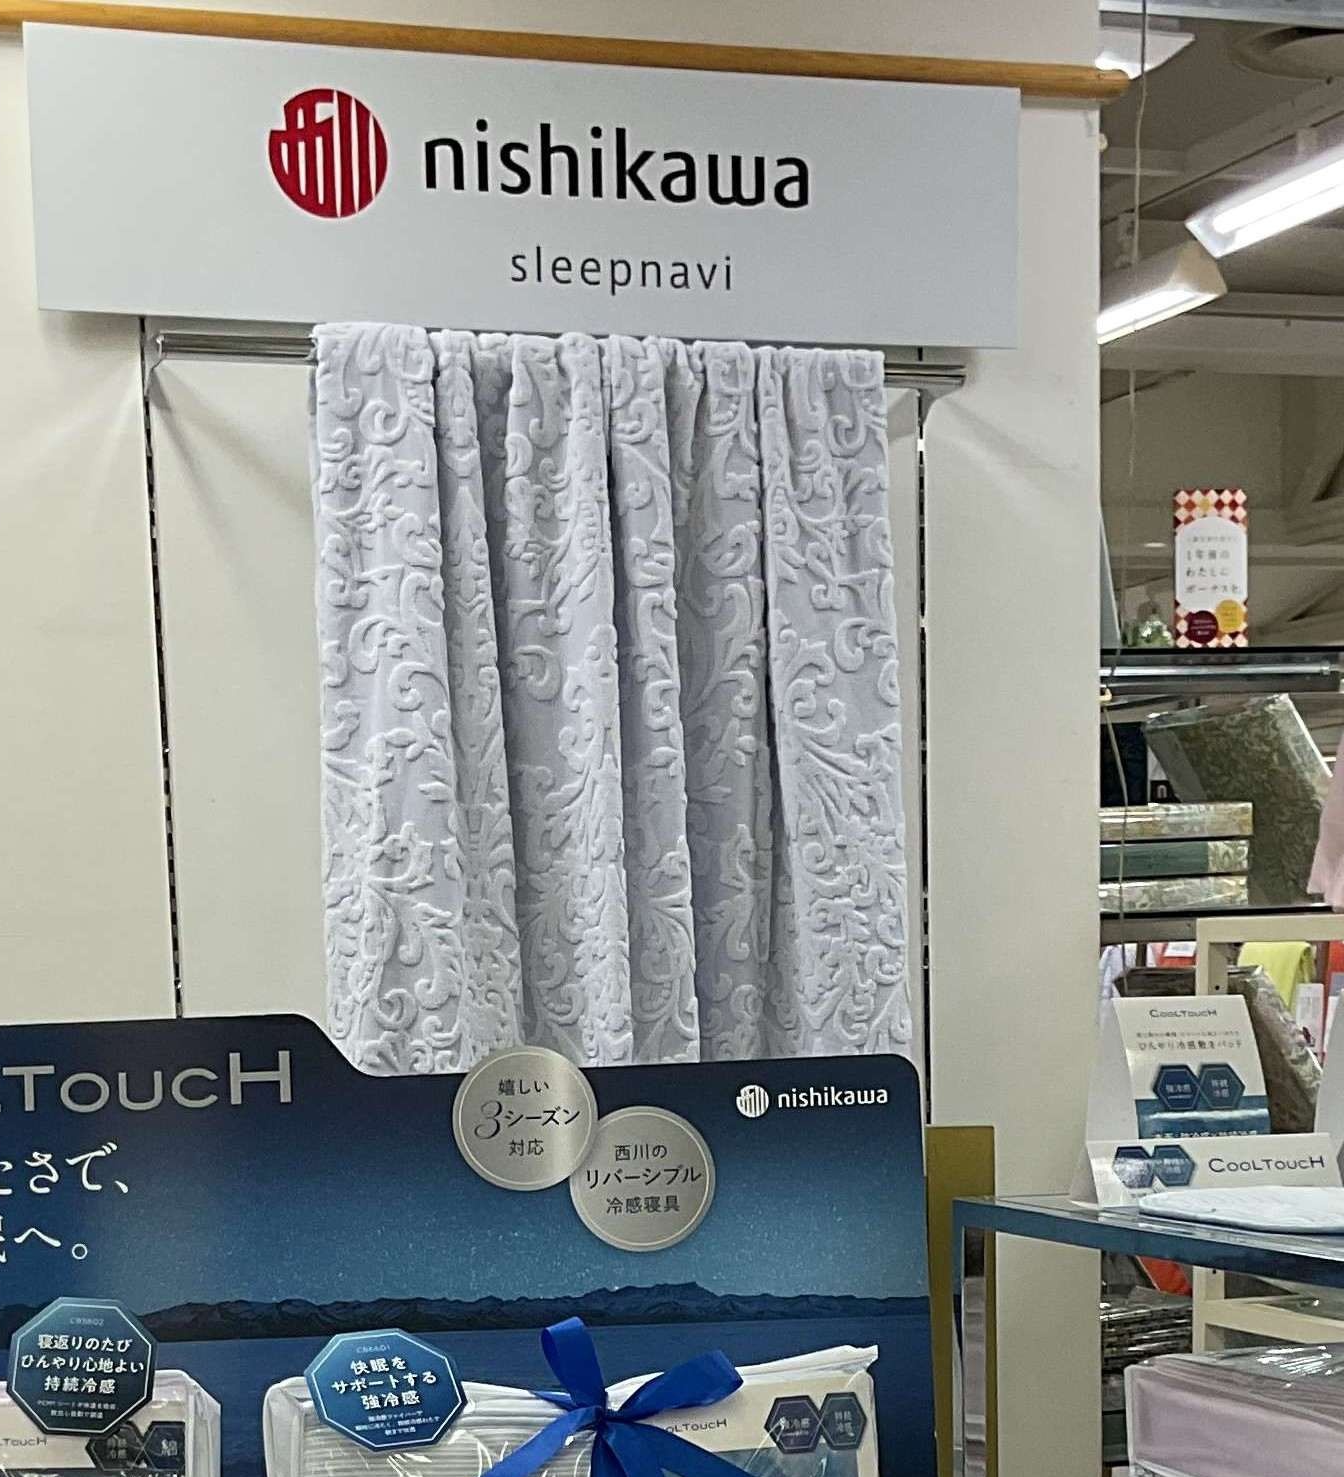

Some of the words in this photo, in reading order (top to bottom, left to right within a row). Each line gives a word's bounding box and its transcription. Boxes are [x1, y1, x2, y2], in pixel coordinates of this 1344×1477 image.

[423, 119, 811, 209] nishikawa
[509, 246, 735, 297] sleepnavi
[498, 1079, 550, 1096] 嬉しい
[777, 1085, 889, 1110] nishikawa
[474, 1101, 581, 1140] 3シーズン
[508, 1139, 545, 1157] 対応
[614, 1143, 668, 1162] 西川の
[585, 1164, 703, 1190] リバーシブル
[605, 1195, 681, 1215] 冷感寝具
[38, 1333, 133, 1353] 寝返りのたび
[20, 1354, 145, 1374] ひんやり心地よい
[349, 1355, 407, 1376] 快眠を
[43, 1375, 117, 1394] 持続冷感
[330, 1370, 437, 1395] サポートする
[360, 1389, 421, 1410] 強冷感
